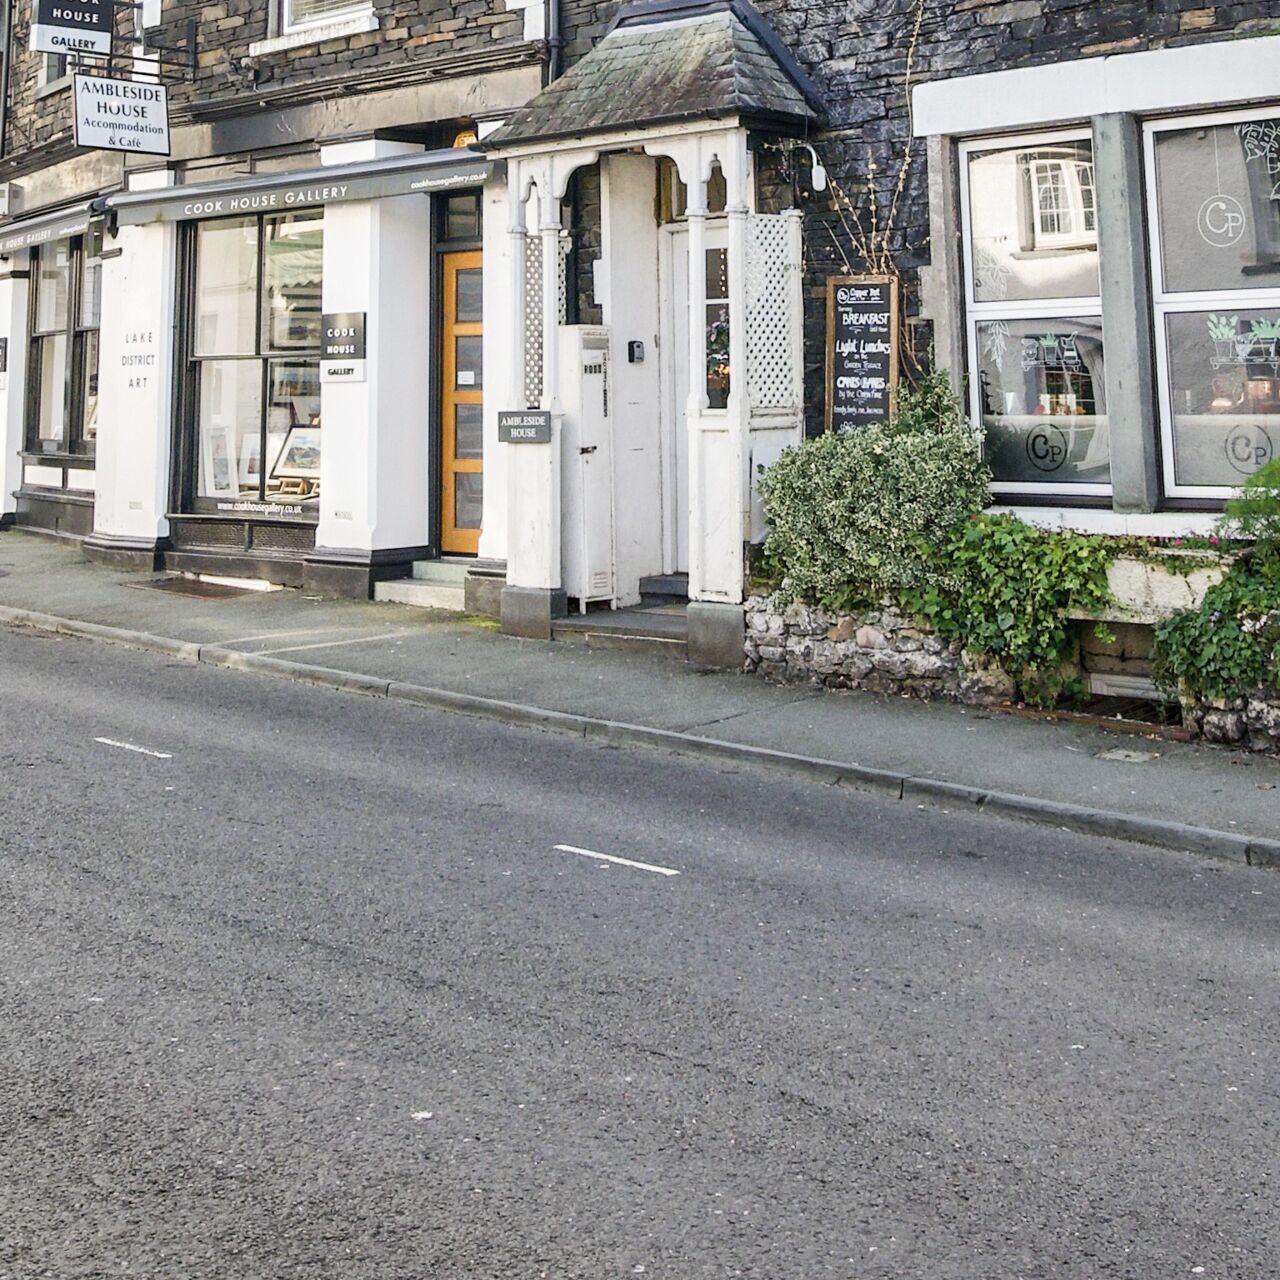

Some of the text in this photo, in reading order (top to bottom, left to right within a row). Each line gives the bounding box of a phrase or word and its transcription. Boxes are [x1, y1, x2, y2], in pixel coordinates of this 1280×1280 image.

[52, 8, 99, 24] HOUSE
[51, 36, 96, 50] GALLERY
[81, 81, 162, 102] AMBLESIDE
[97, 101, 148, 119] HOUSE
[83, 118, 164, 134] Accommodation
[108, 136, 141, 148] & Café
[411, 171, 487, 189] cookhousegallery.co.uk
[184, 185, 349, 216] COOK HOUSE GALLERY
[6, 237, 24, 249] HOUSE
[27, 229, 51, 244] GALLERY
[842, 313, 890, 325] BREAKFAST
[125, 331, 152, 343] LAKE
[327, 328, 355, 338] COOK
[327, 344, 355, 354] HOUSE
[836, 339, 890, 357] Light Lunches
[122, 354, 155, 366] DISTRICT
[129, 377, 147, 388] ART
[501, 416, 546, 426] AMBLESIDE
[511, 428, 536, 438] HOUSE
[217, 502, 302, 517] www.cookhousegallery.co.uk
